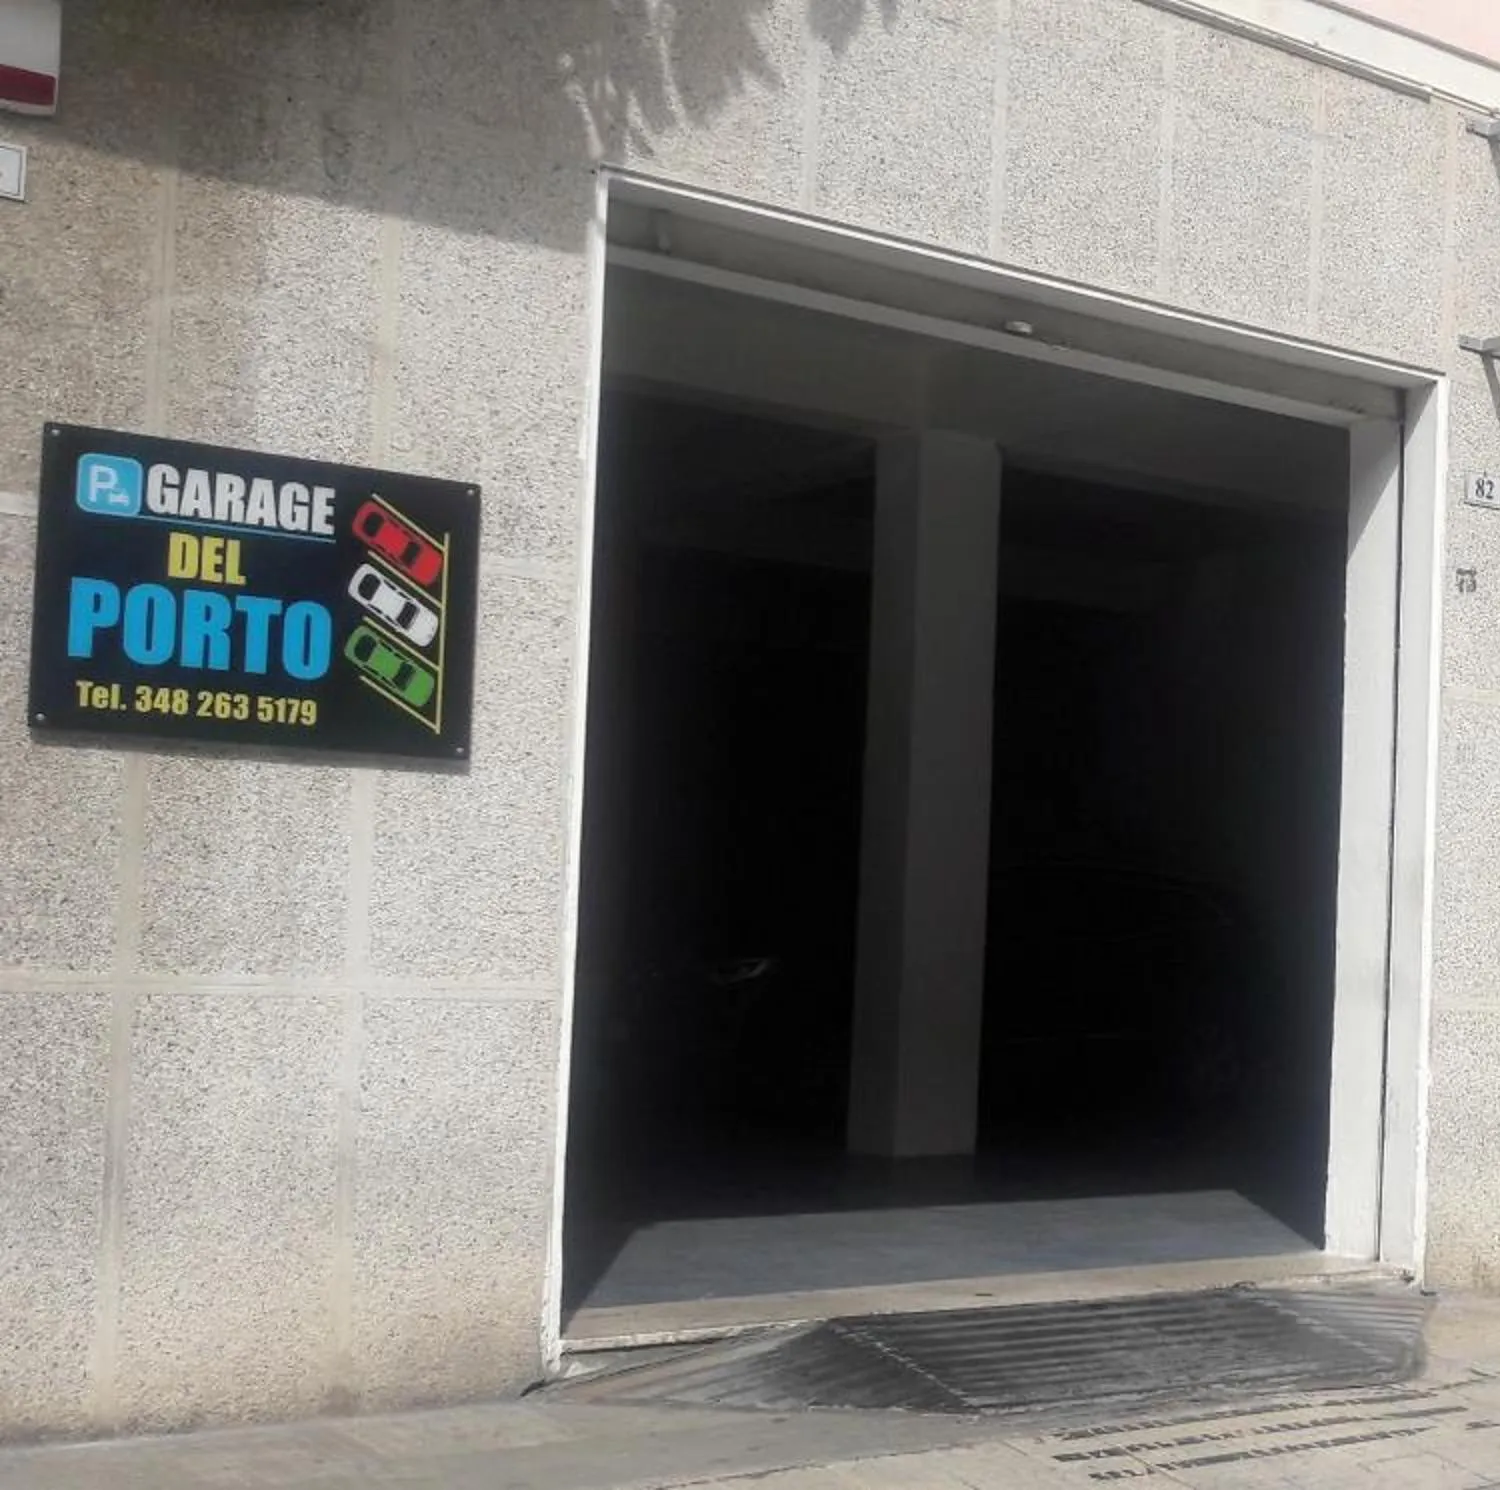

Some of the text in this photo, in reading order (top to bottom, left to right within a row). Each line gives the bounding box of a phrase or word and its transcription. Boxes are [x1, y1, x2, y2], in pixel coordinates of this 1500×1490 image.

[87, 463, 337, 536] P GARAGE
[1474, 477, 1495, 500] 82
[167, 532, 247, 586] DEL
[67, 576, 334, 681] PORTO
[75, 679, 318, 726] Tel. 348 263 5179
